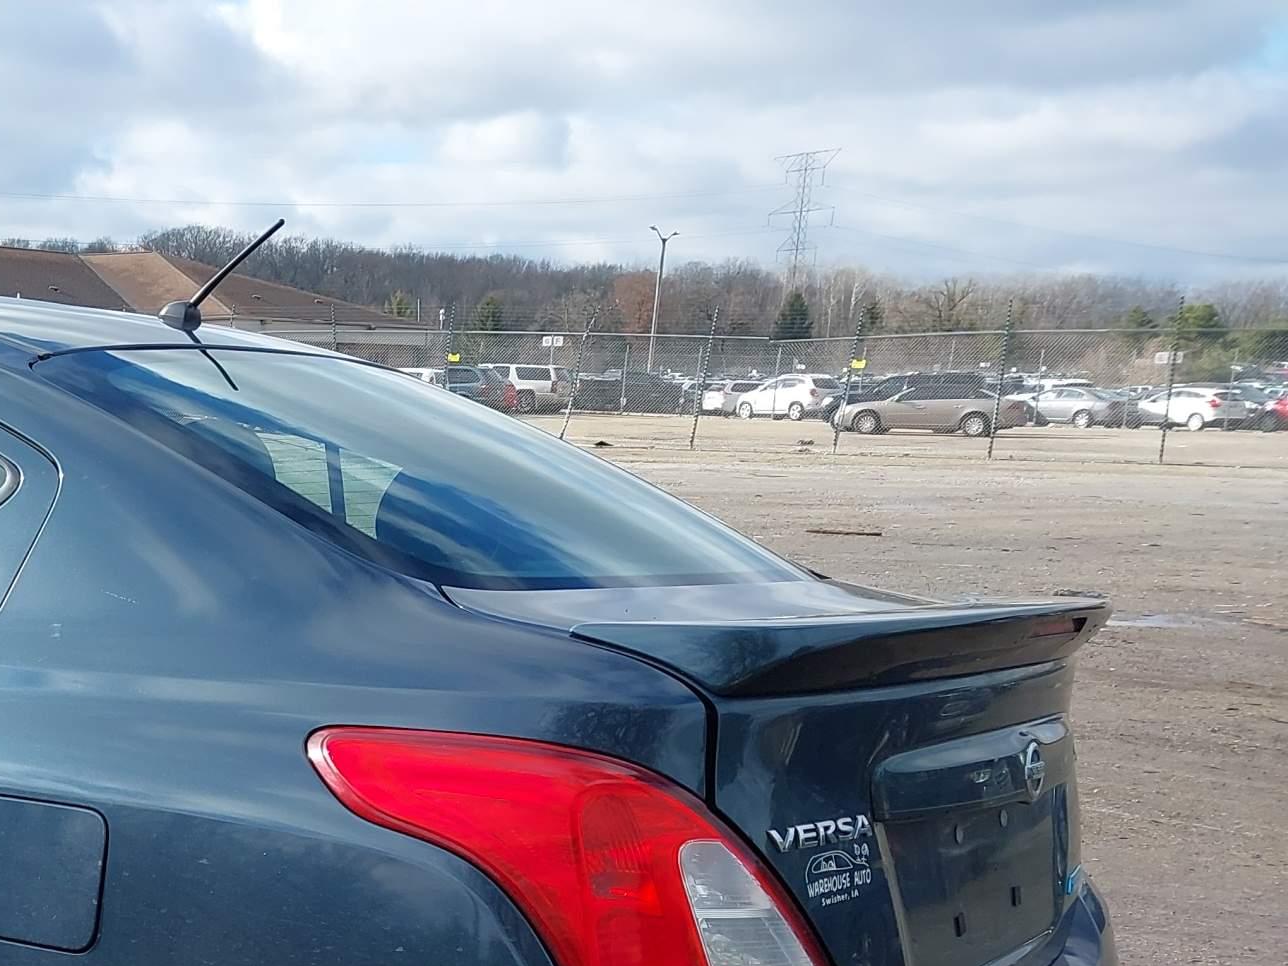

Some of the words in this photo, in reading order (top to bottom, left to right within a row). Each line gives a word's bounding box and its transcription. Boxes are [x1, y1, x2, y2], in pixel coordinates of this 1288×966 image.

[766, 815, 872, 853] VERSA
[806, 873, 851, 898] WAREHOUSE
[853, 869, 872, 886] AUTO
[821, 892, 851, 907] Swisher,
